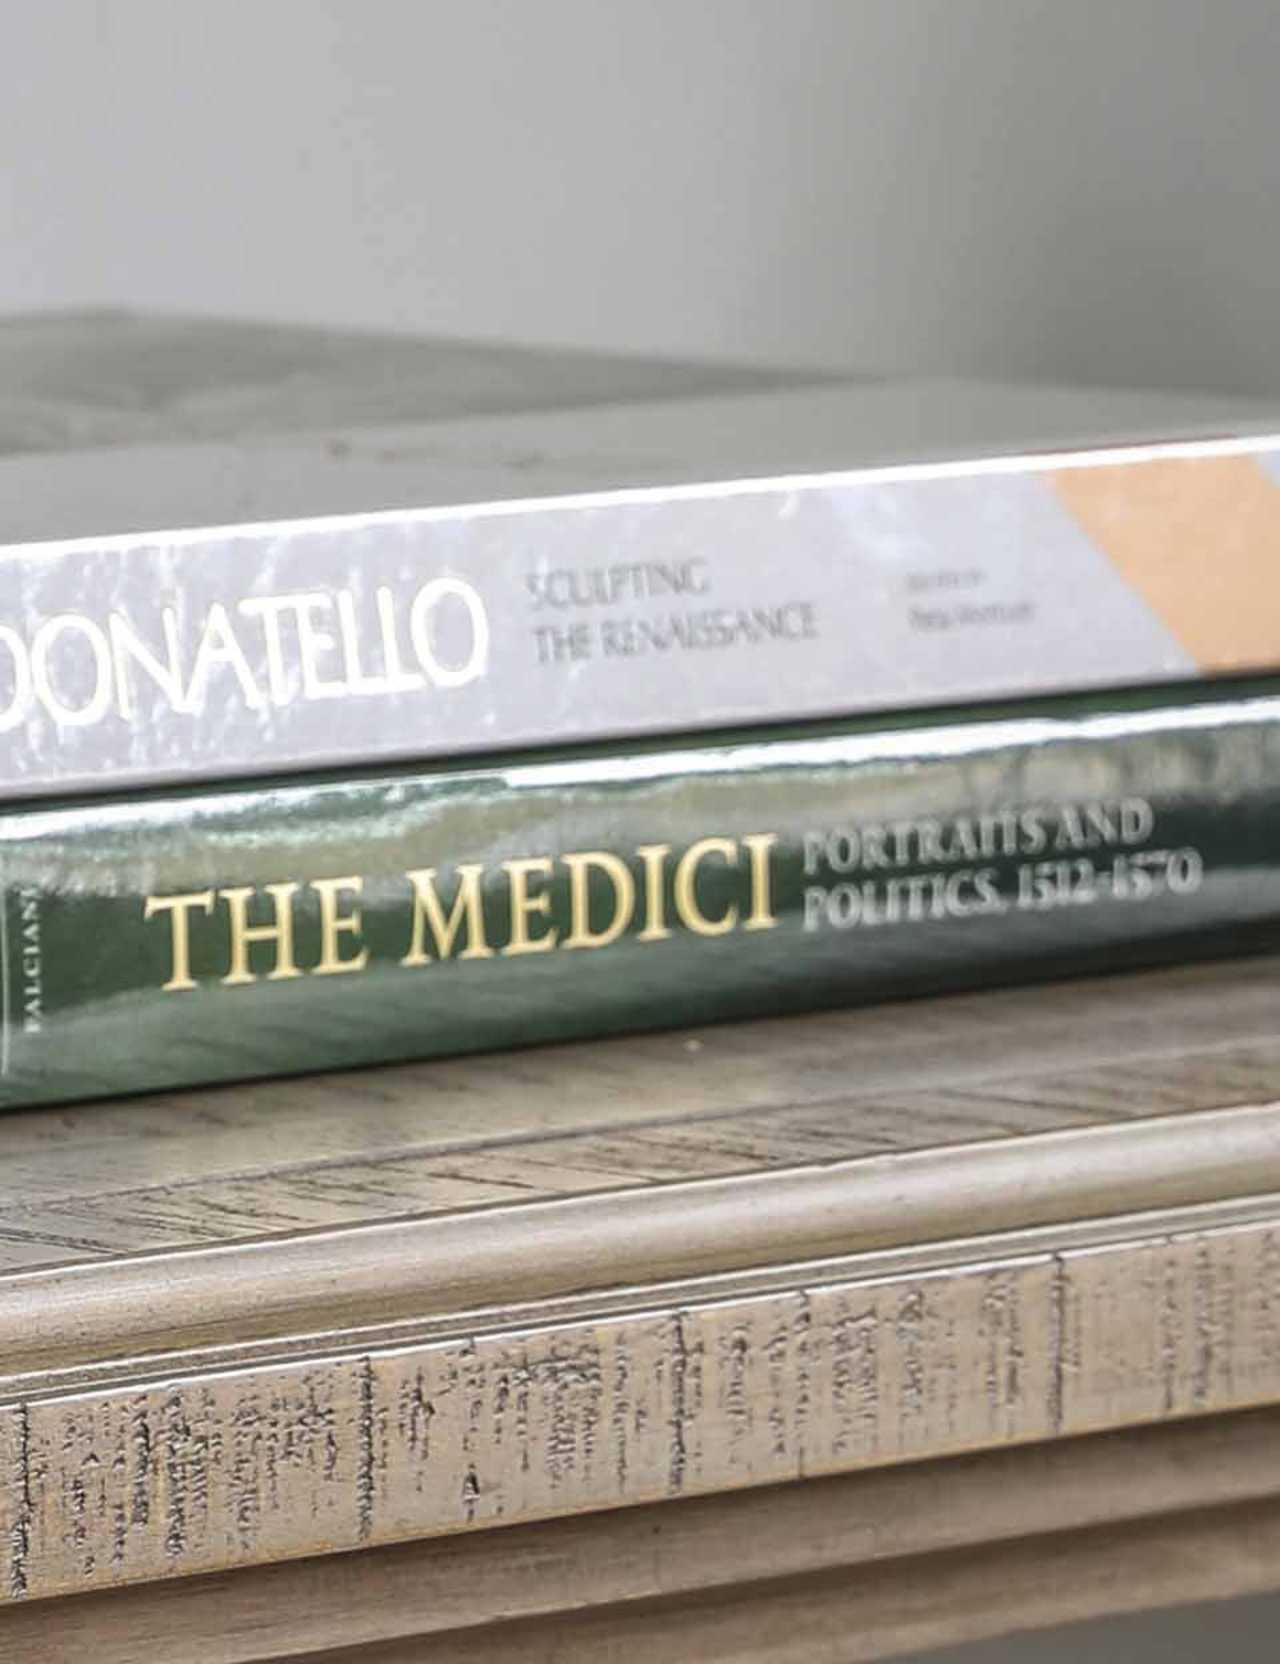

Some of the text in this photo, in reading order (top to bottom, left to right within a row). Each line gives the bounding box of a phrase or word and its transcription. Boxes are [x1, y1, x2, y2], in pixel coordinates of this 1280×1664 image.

[524, 555, 711, 609] SCULPTING
[531, 601, 818, 664] THE RENAISSANCE
[802, 796, 1154, 876] PORTRAITS AND
[144, 833, 780, 992] THE MEDICI
